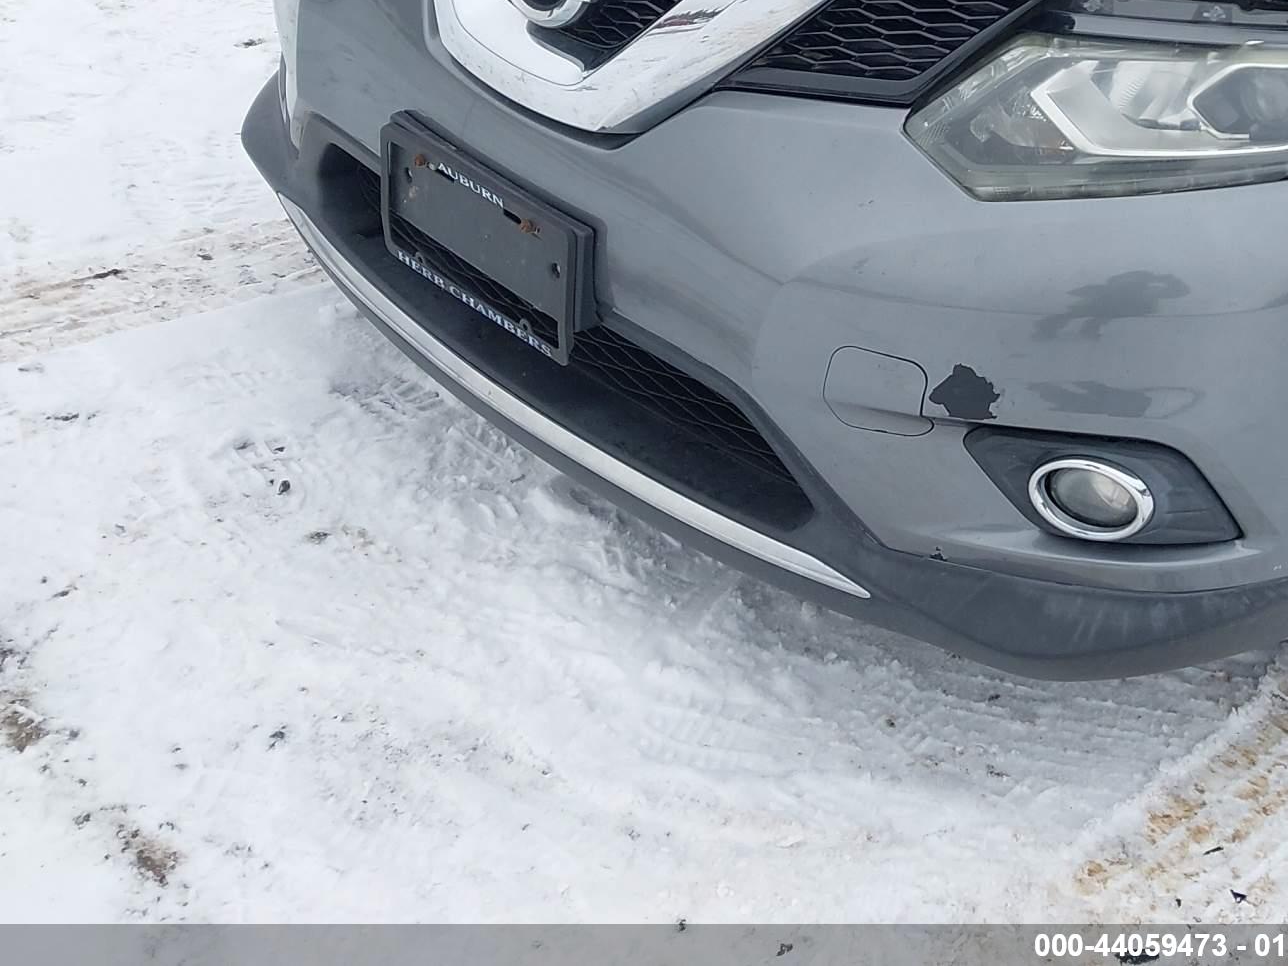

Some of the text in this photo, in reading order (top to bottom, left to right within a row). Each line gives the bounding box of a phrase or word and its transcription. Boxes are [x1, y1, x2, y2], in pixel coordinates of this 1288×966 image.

[437, 162, 504, 208] AUBURN
[397, 250, 552, 357] HERB CHAMBERS
